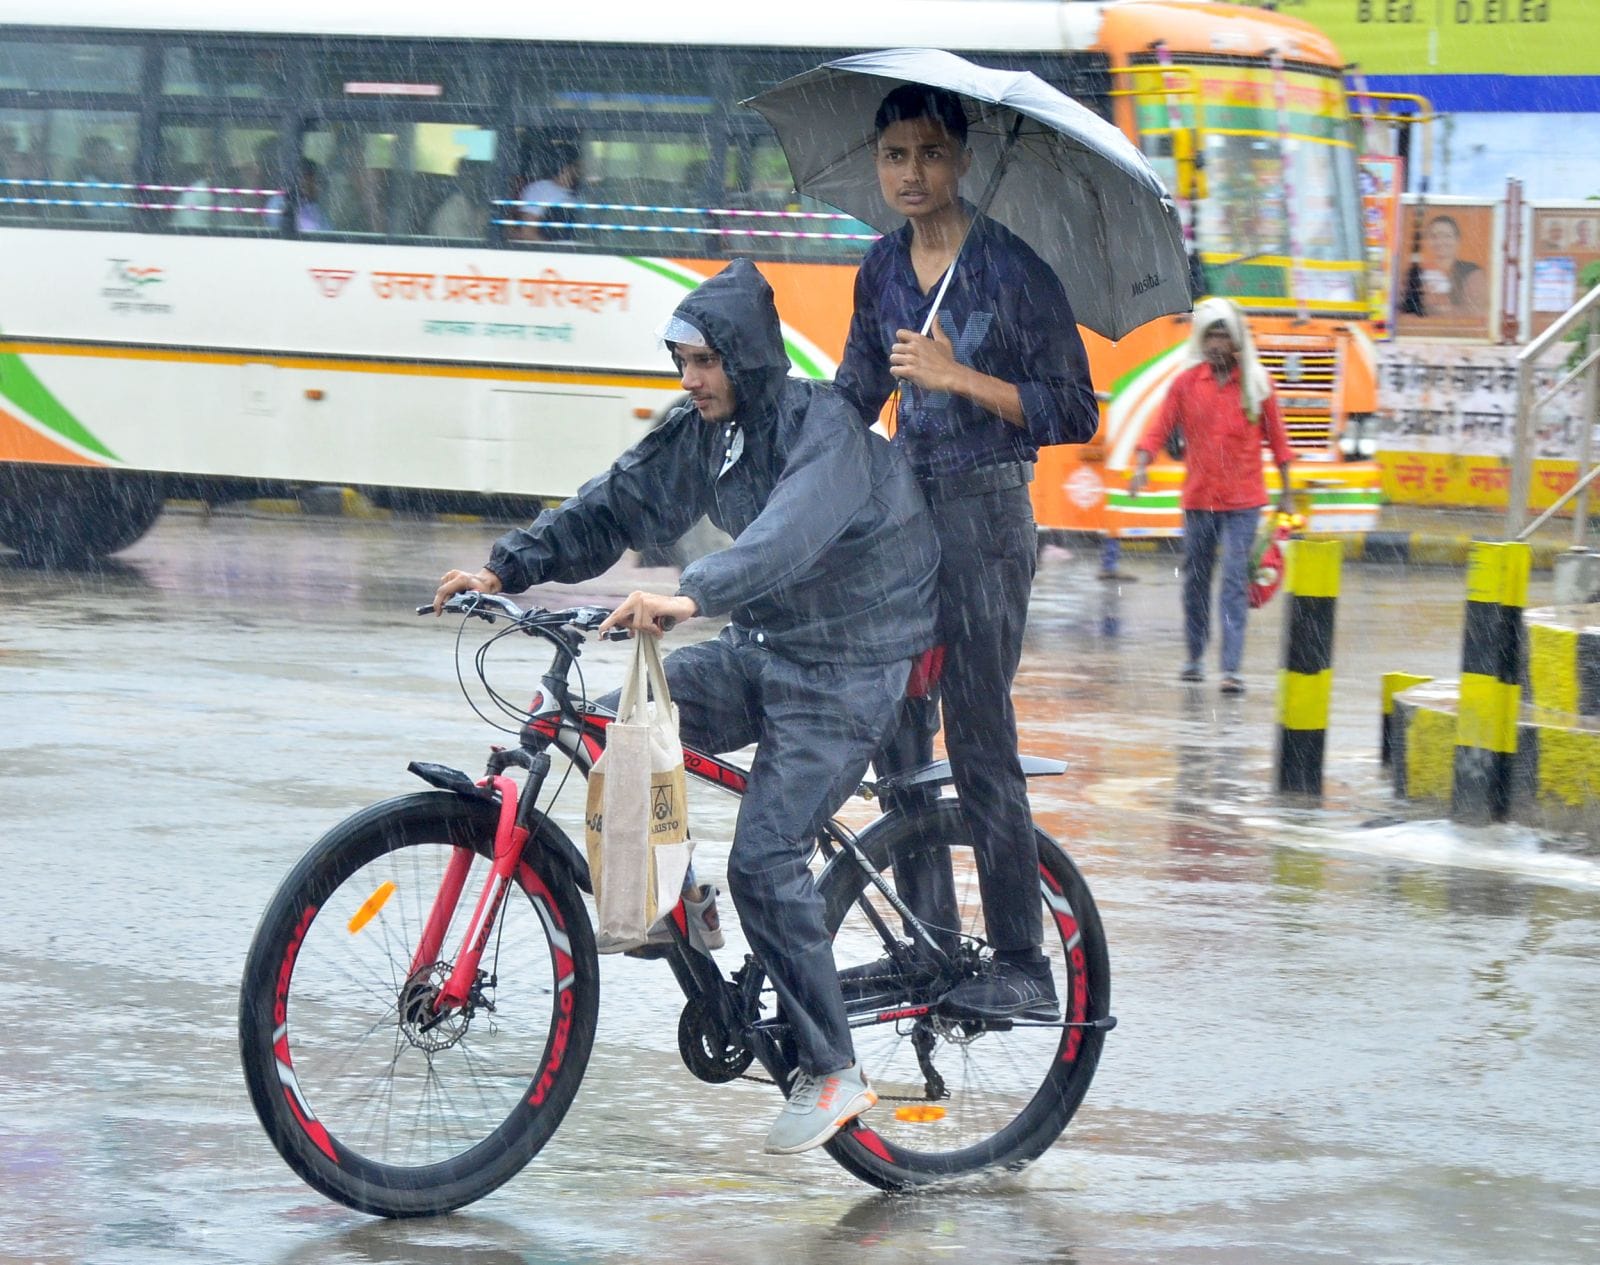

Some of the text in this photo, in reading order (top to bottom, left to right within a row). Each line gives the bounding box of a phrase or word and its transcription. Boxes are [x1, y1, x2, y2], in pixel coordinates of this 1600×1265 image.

[370, 264, 631, 313] उत्तर प्रदेश परिवहन
